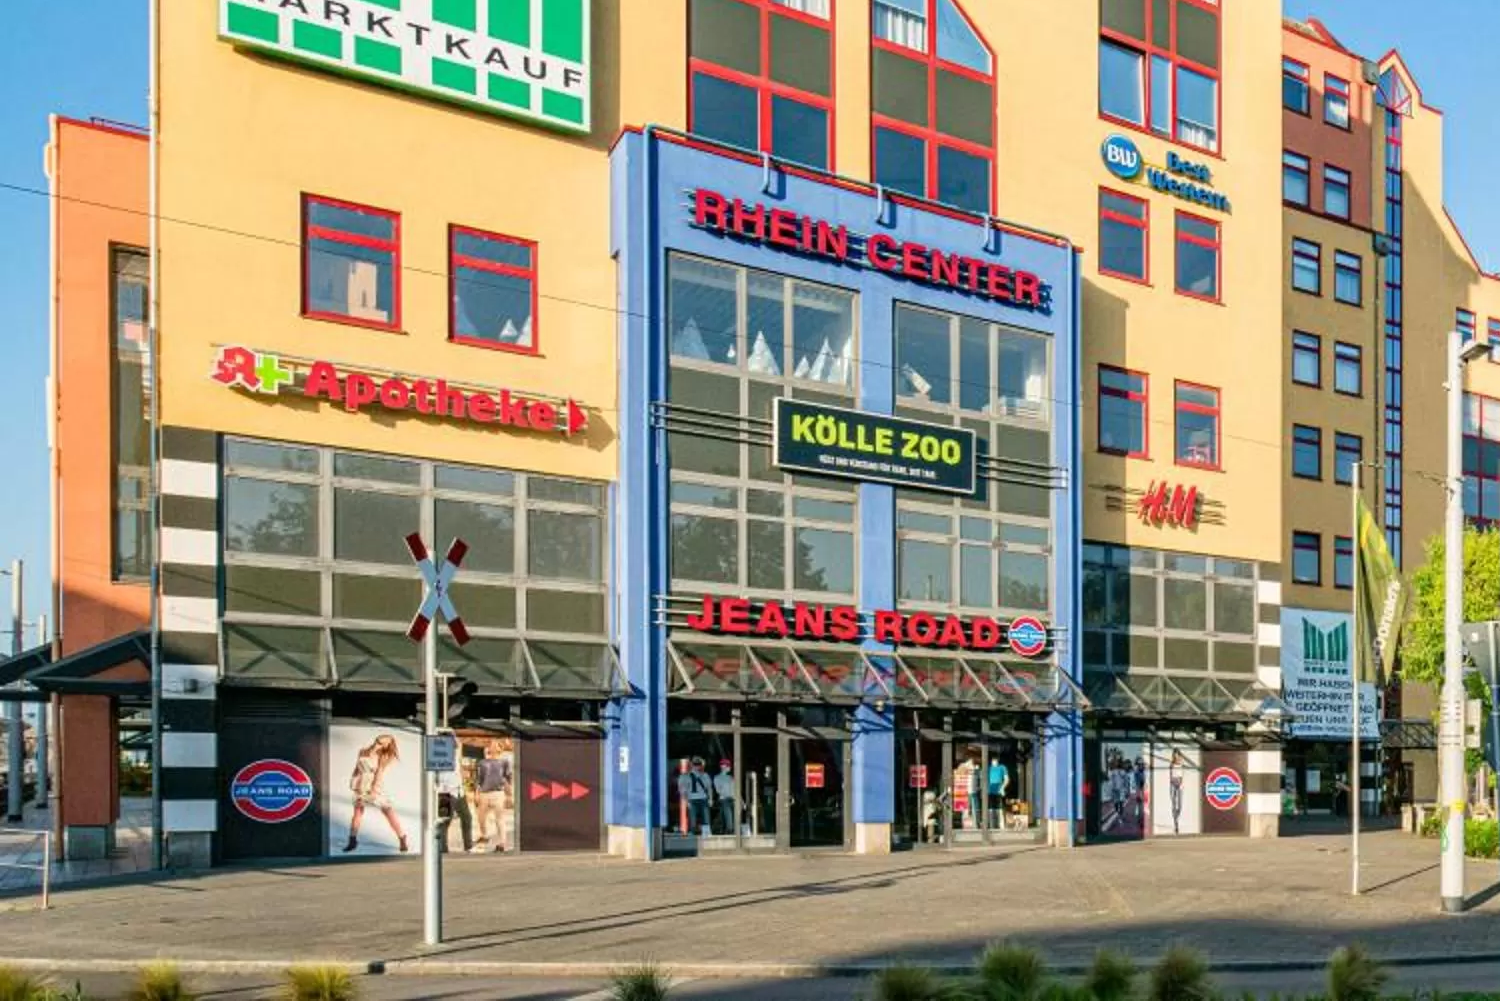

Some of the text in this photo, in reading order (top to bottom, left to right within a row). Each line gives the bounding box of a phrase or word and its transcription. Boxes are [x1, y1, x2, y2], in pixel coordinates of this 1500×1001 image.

[1107, 144, 1137, 167] BW
[693, 187, 1043, 305] RHEIN CENTER
[303, 360, 557, 431] Apotheke
[792, 414, 961, 466] KÖLLE ZOO
[686, 594, 1002, 650] JEANS ROAD
